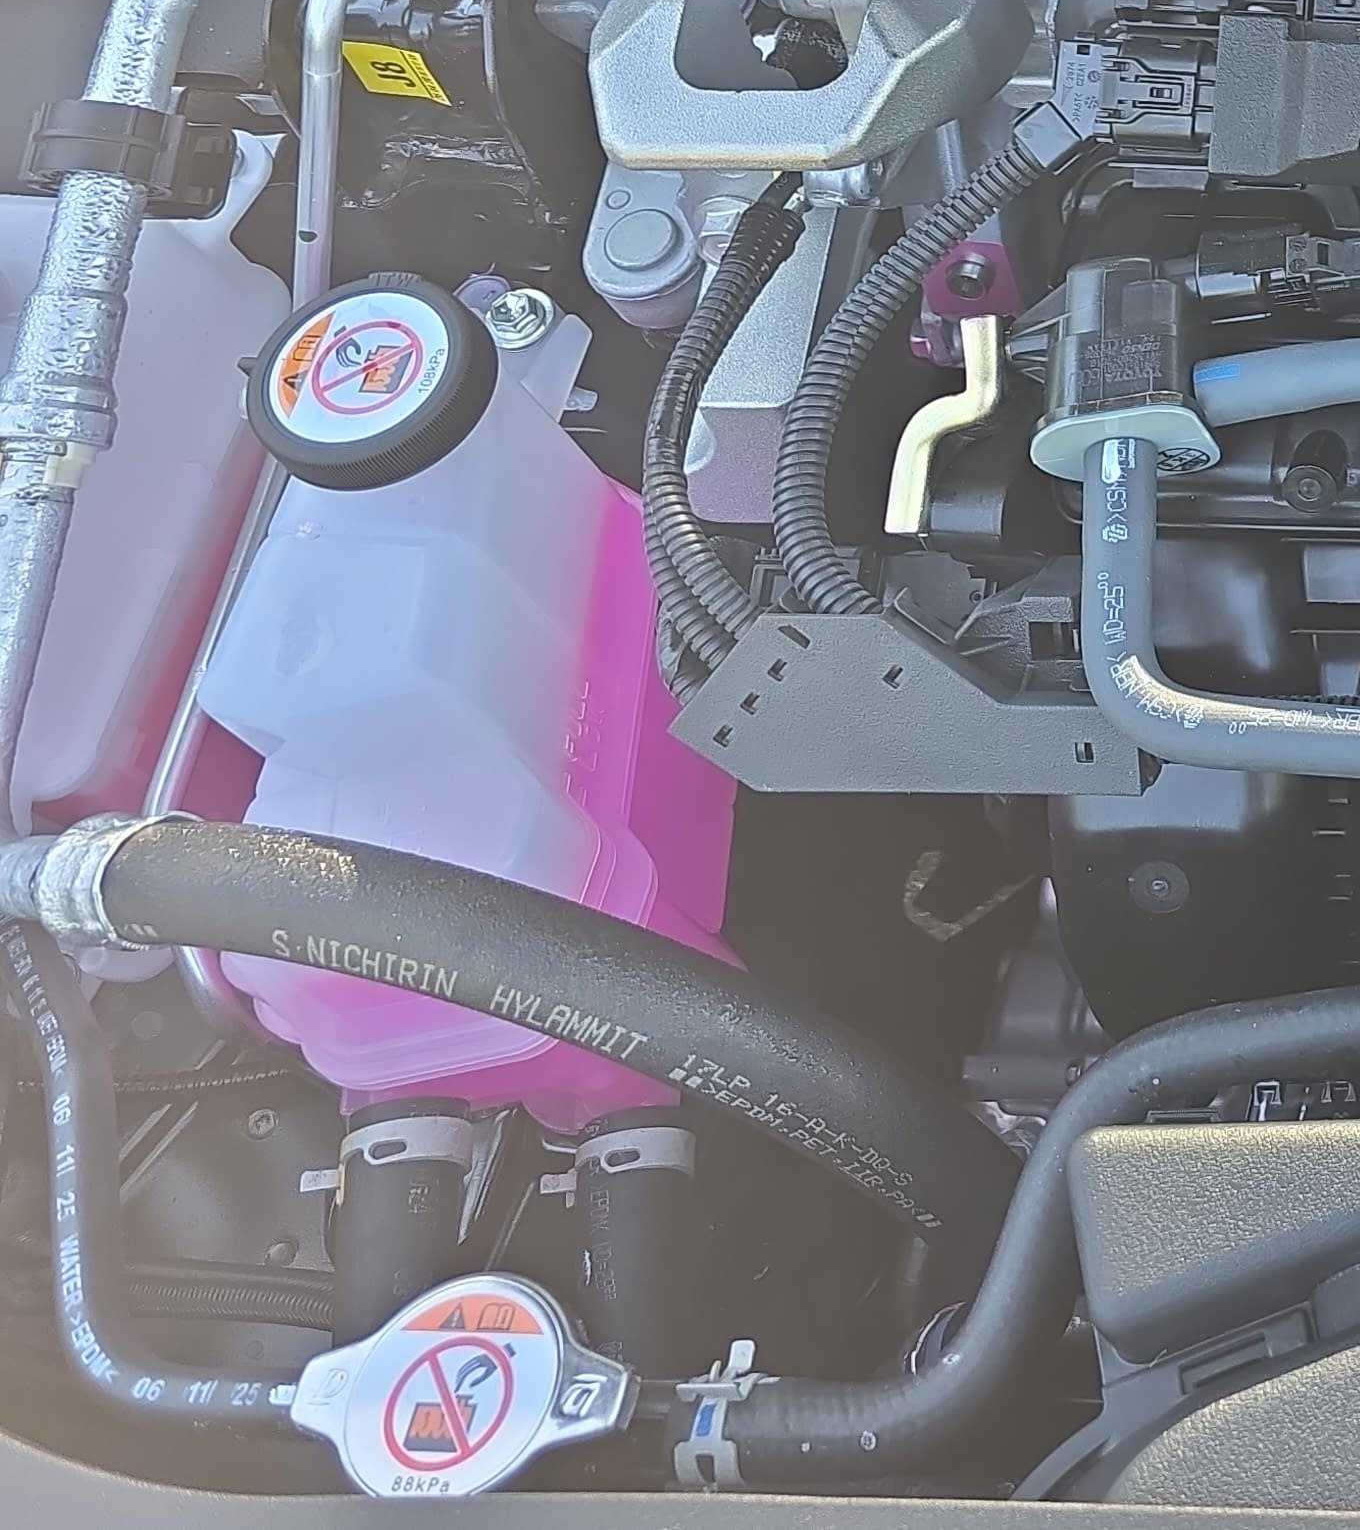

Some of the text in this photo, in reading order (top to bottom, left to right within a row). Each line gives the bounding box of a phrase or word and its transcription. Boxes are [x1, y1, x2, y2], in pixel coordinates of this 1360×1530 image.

[370, 61, 416, 87] J8
[418, 348, 445, 394] 108kPa
[489, 984, 649, 1060] HYLAMMIT
[52, 1094, 71, 1125] 06
[56, 1191, 76, 1222] 25
[131, 1377, 166, 1402] 06
[391, 1476, 451, 1494] 88kPa
